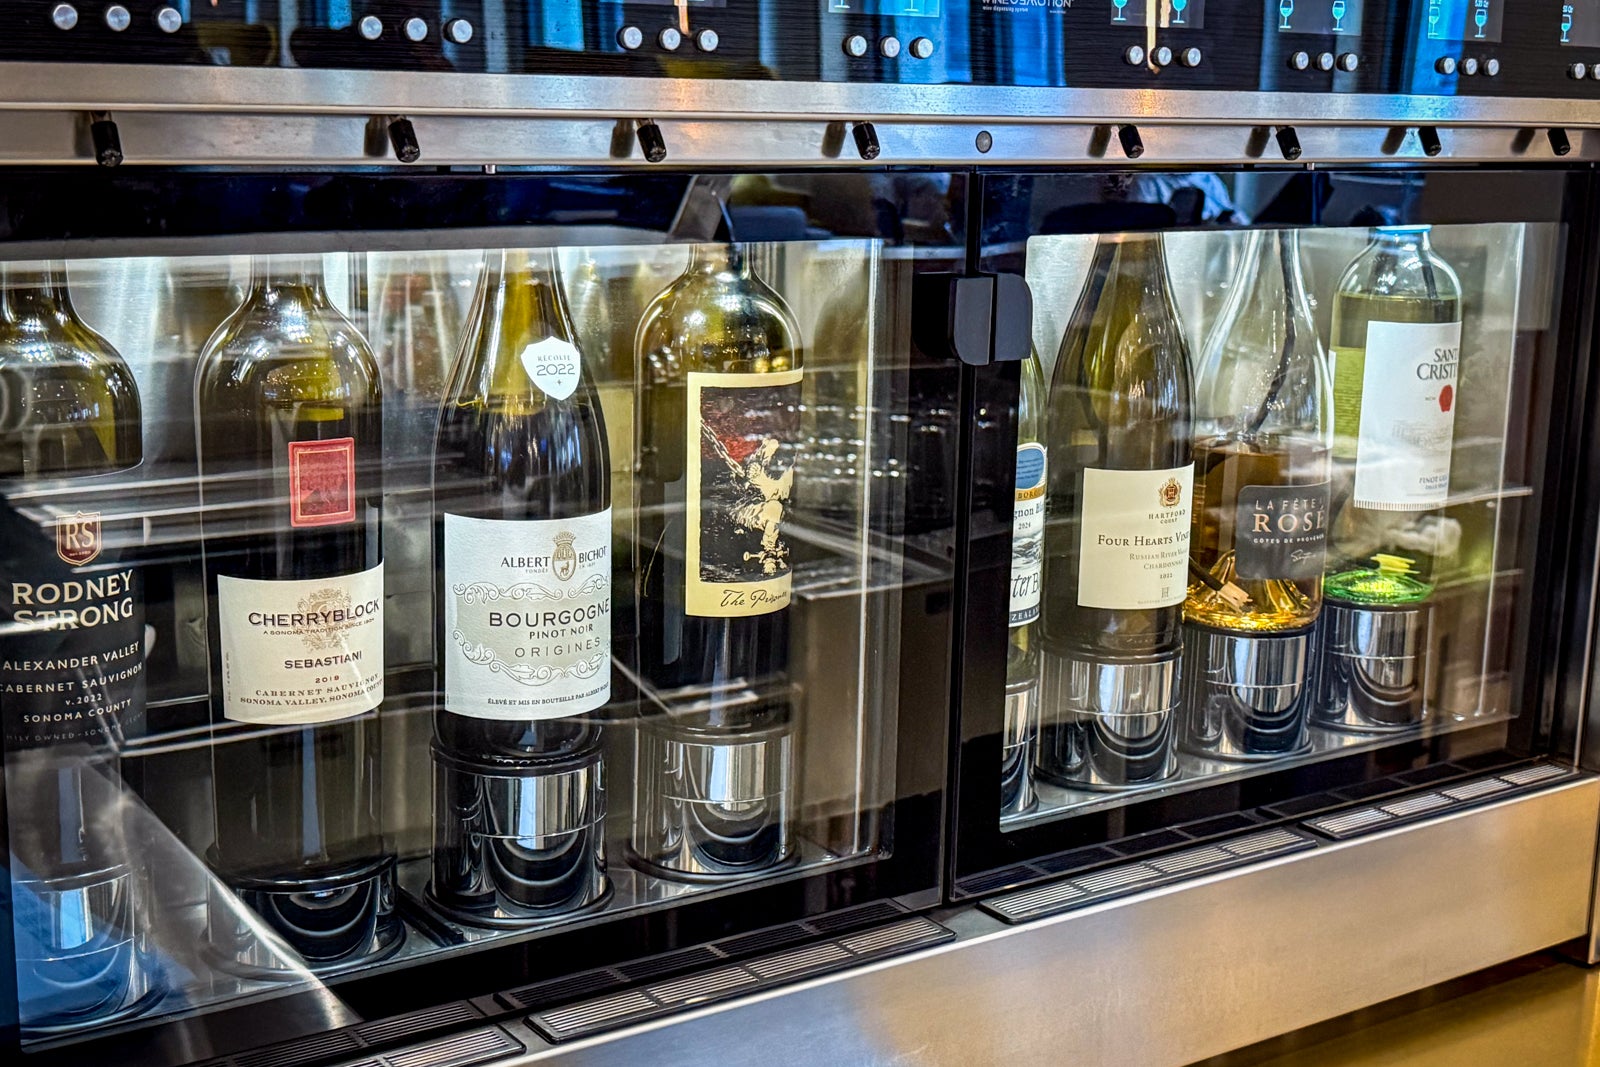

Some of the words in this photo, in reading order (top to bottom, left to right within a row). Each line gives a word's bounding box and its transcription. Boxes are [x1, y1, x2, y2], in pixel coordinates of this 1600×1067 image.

[536, 363, 576, 377] 2022
[1148, 508, 1186, 520] HARTFORD
[1255, 499, 1275, 511] LA
[65, 519, 96, 551] RS
[1097, 534, 1130, 547] FOUR
[1134, 535, 1174, 547] HEARTS
[500, 556, 551, 568] ALBERT
[579, 545, 607, 564] BICHOT
[11, 568, 134, 605] RODNEY
[720, 589, 746, 608] The
[13, 596, 134, 632] STRONG
[248, 598, 380, 628] CHERRYBLOCK
[489, 597, 610, 628] BOURGOGNE
[269, 627, 303, 637] SONOMA
[529, 629, 566, 640] PINOT
[570, 623, 594, 636] NOIR
[3, 655, 99, 671] ALEXANDER
[102, 641, 140, 662] VALLEY
[514, 636, 601, 658] ORIGINES
[284, 650, 362, 669] SEBASTIANI
[82, 662, 143, 690] SAUVIGNON
[255, 687, 322, 698] CABERNET
[326, 672, 380, 693] SAUVIGNON
[240, 696, 283, 706] SONOMA
[328, 690, 366, 702] SONOMA
[541, 694, 575, 705] BOUTEILLE
[575, 692, 585, 700] PAR
[23, 711, 83, 724] SONOMA
[87, 697, 132, 718] COUNTY
